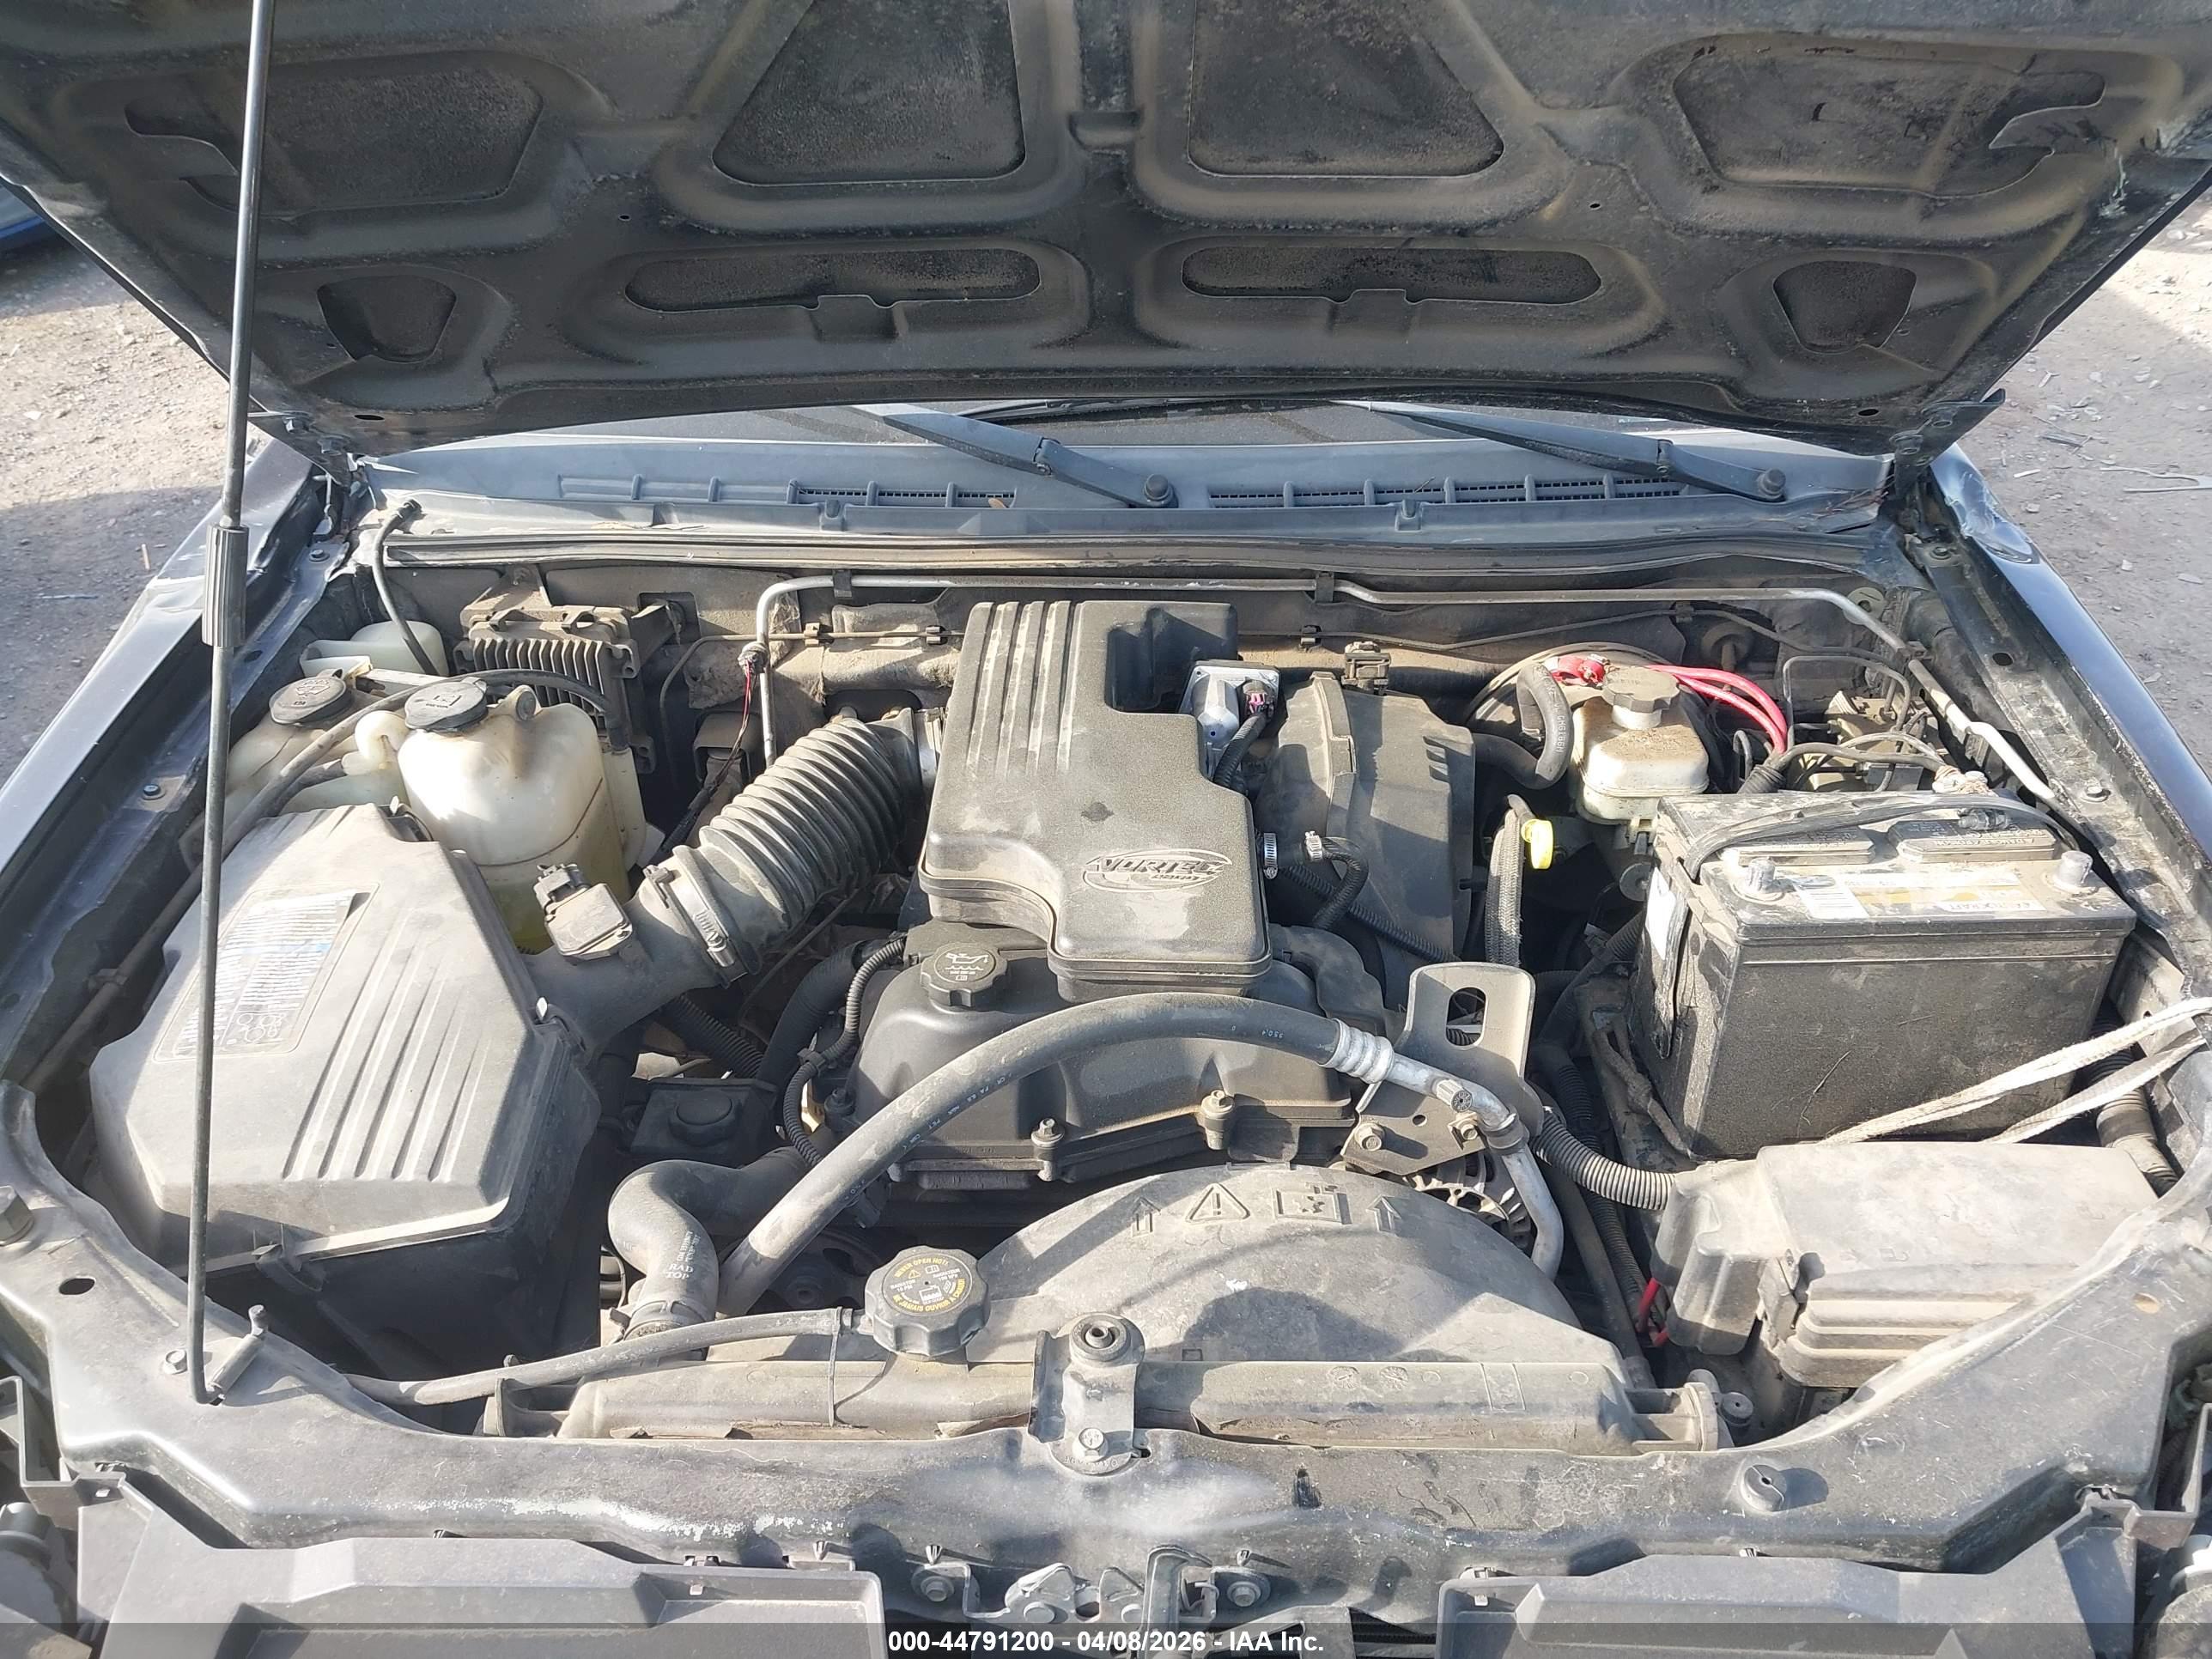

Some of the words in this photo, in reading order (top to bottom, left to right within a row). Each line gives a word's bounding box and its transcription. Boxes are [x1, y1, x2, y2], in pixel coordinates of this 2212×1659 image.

[1099, 858, 1224, 876] VORTEC
[669, 1262, 694, 1273] RAD
[894, 1262, 914, 1279] NEVER
[912, 1257, 932, 1267] OPEN
[665, 1271, 690, 1279] TOP
[890, 1279, 916, 1290] RADIATOR
[898, 1300, 925, 1312] JAMAIS
[925, 1299, 951, 1312] OUVRIR
